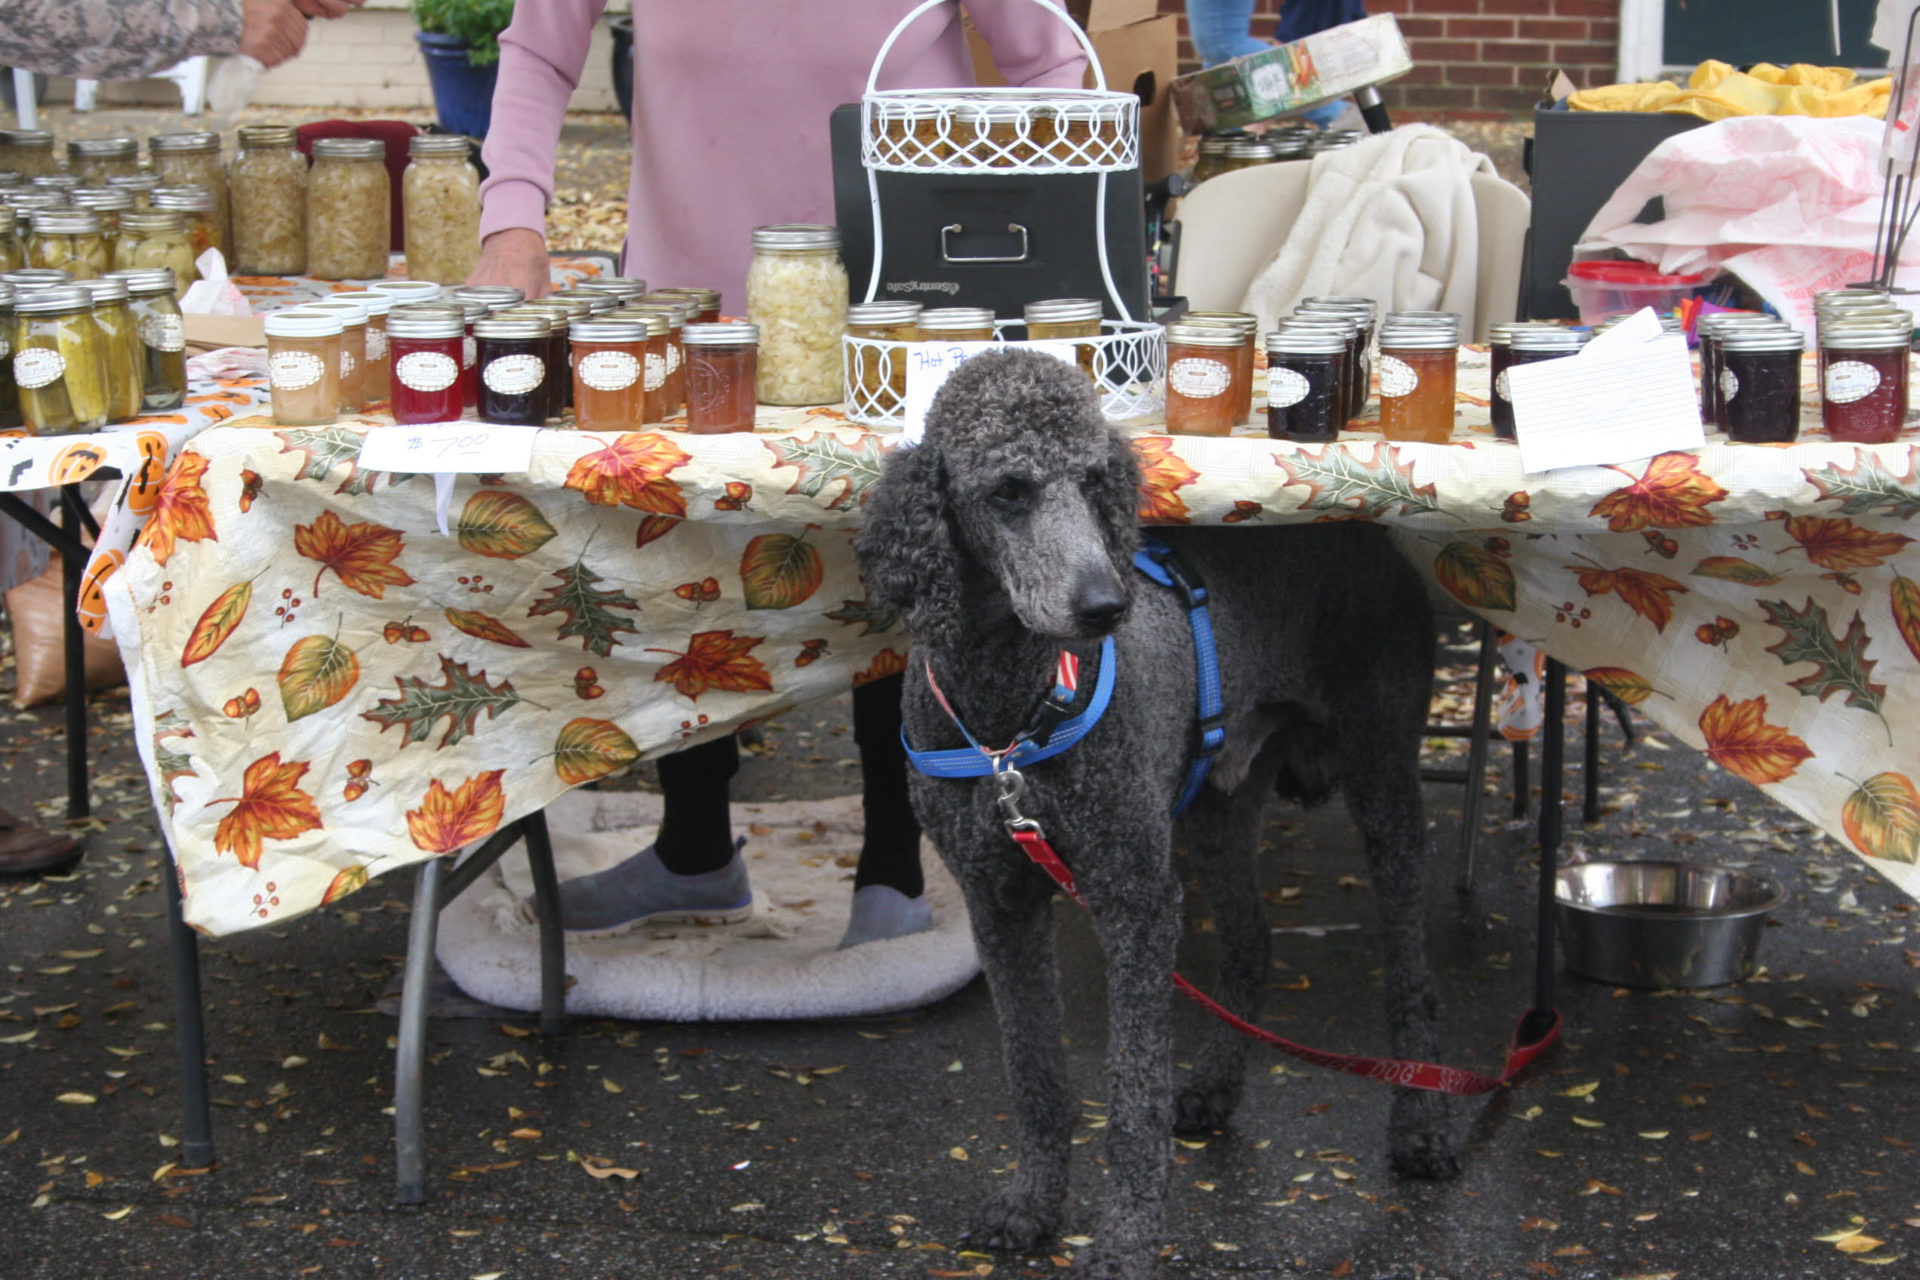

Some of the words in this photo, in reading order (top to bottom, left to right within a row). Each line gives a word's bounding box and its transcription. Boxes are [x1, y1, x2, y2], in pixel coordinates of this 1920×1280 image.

[886, 280, 952, 293] SentrySafe
[913, 349, 944, 371] Hot
[1368, 1061, 1415, 1085] DOG
